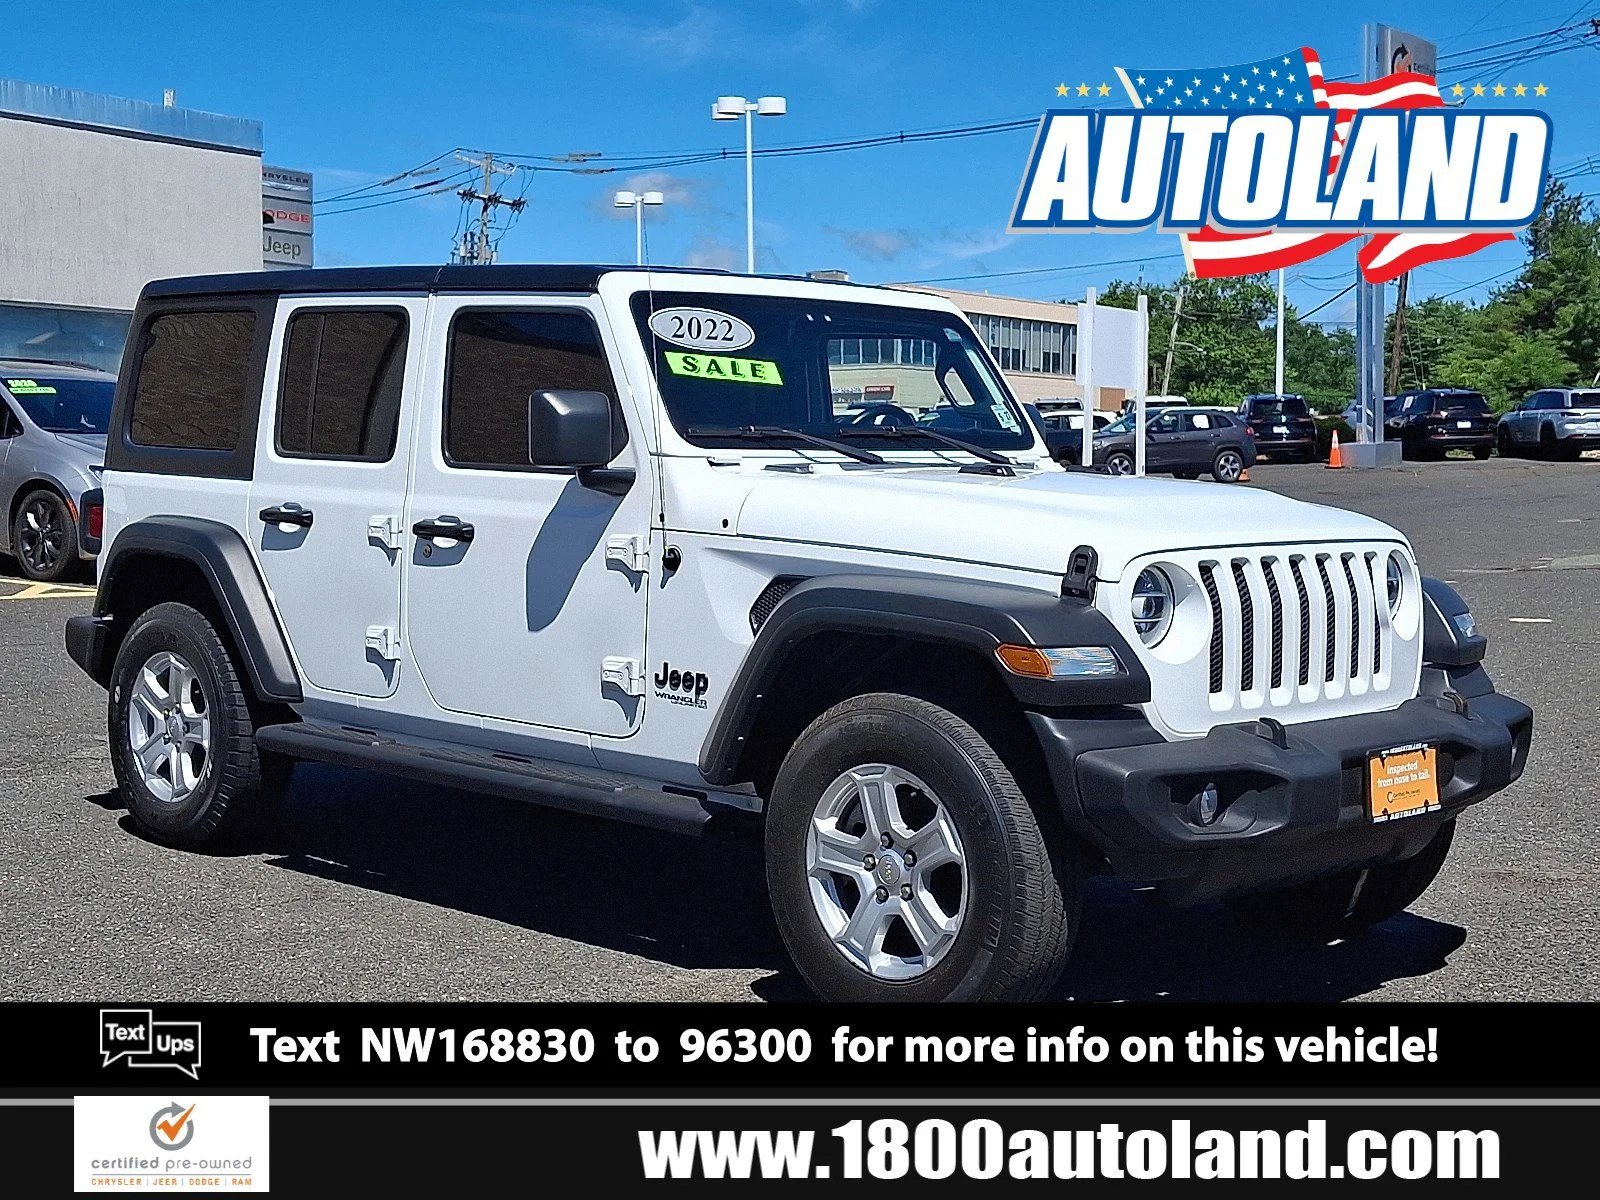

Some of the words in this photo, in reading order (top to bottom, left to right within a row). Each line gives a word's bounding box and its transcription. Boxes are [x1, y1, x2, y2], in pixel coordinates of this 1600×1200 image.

[263, 236, 301, 259] Jeep
[670, 316, 735, 341] 2022
[682, 355, 766, 380] SALE
[654, 662, 709, 701] Jeep
[654, 691, 708, 706] WRANGLER
[1387, 760, 1418, 775] Inspected
[1377, 778, 1394, 788] from
[1394, 776, 1410, 785] nose
[1411, 772, 1418, 781] to
